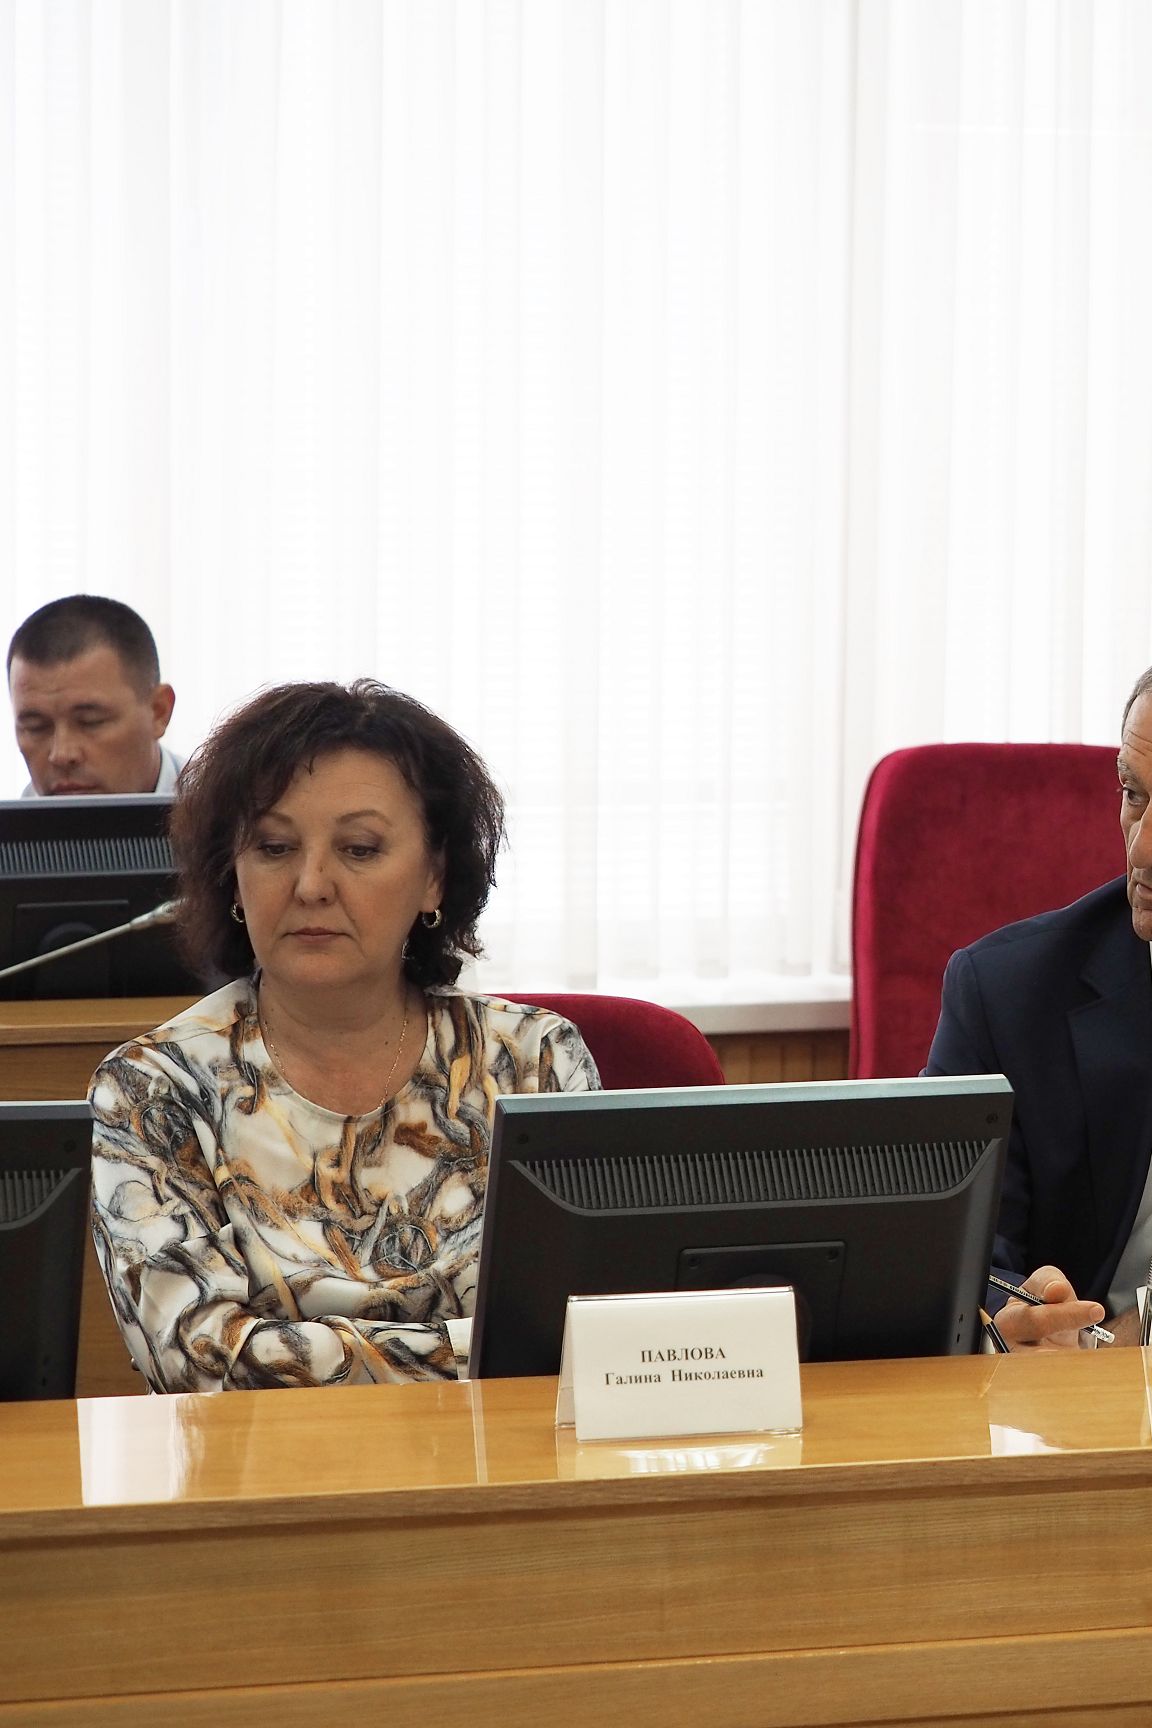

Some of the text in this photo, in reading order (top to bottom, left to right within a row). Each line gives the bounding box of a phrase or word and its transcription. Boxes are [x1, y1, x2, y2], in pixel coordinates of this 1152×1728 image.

[640, 1347, 726, 1363] ПАВЛОВА
[605, 1368, 764, 1386] Галина Николаевна
